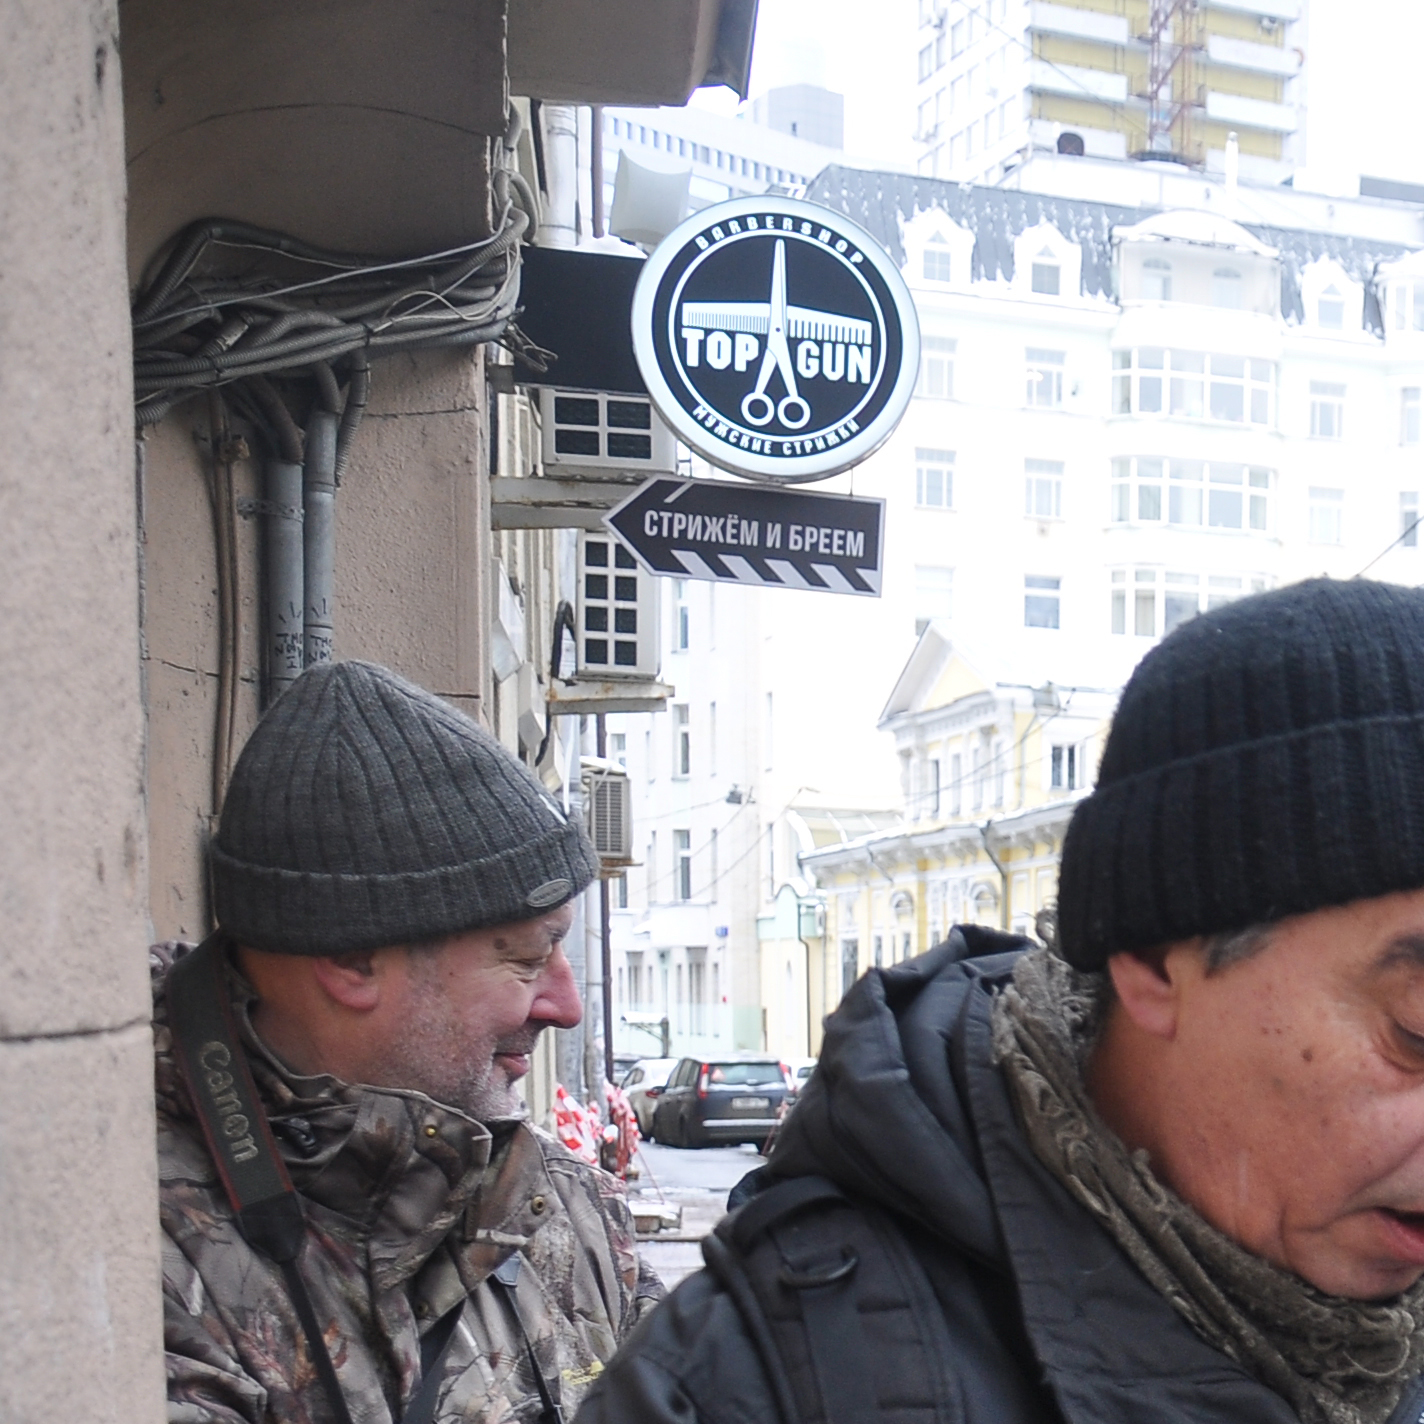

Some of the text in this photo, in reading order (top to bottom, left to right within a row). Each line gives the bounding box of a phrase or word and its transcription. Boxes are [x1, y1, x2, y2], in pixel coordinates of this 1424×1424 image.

[695, 215, 864, 264] BARBERSHOP
[681, 327, 872, 384] TOP GUN
[692, 405, 861, 456] МУЖСКИЕ СТРИЖКИ
[644, 509, 865, 558] СТРИЖЁМ И БРЕЕМ
[200, 1041, 259, 1163] Canon
